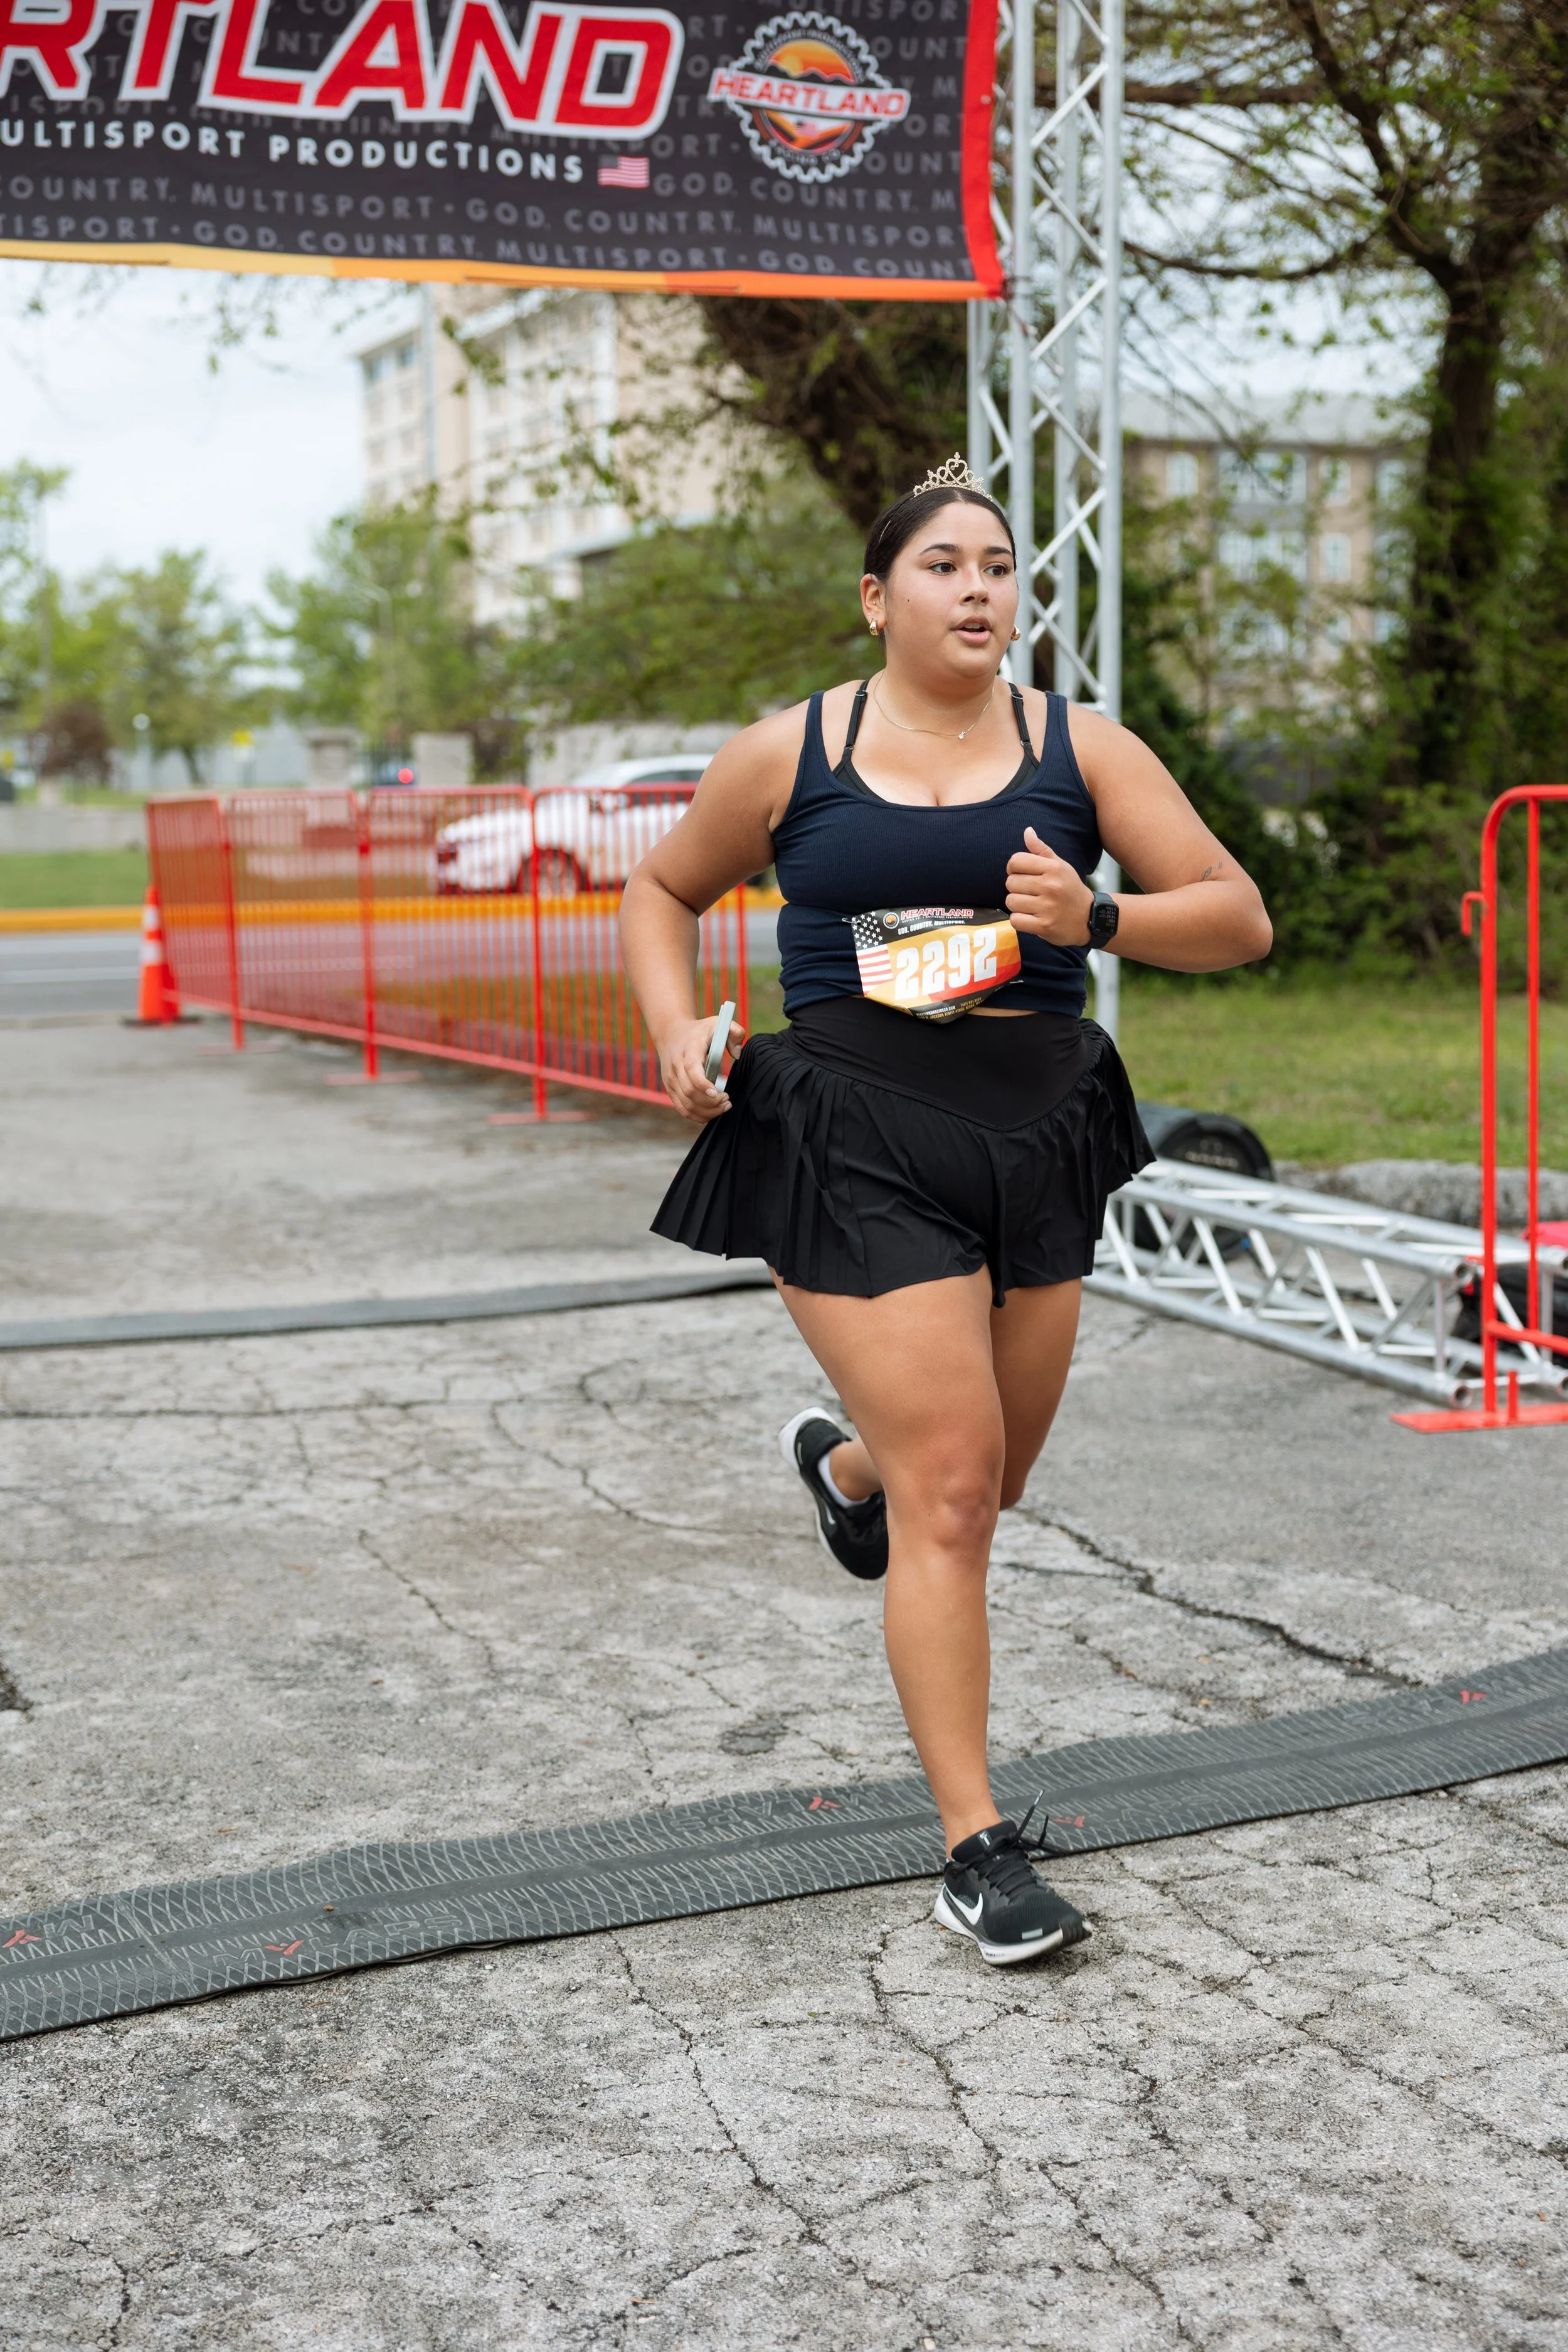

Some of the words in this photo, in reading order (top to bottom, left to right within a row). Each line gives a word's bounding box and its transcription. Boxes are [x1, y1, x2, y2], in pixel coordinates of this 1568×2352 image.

[713, 71, 908, 118] HEARTLAND
[269, 134, 583, 183] PRODUCTIONS
[0, 175, 177, 203] OUNTRY.
[190, 181, 434, 220] MULTISPORT
[754, 214, 968, 248] MULTISPOR
[497, 240, 728, 270] MULTISPORT
[898, 926, 909, 935] GOD.
[910, 920, 933, 932] COUNTRY.
[901, 908, 974, 921] HEARTLAND
[894, 926, 997, 1001] 2292
[667, 1792, 884, 1833] MYLAPS
[212, 1914, 464, 1968] MYLAPS
